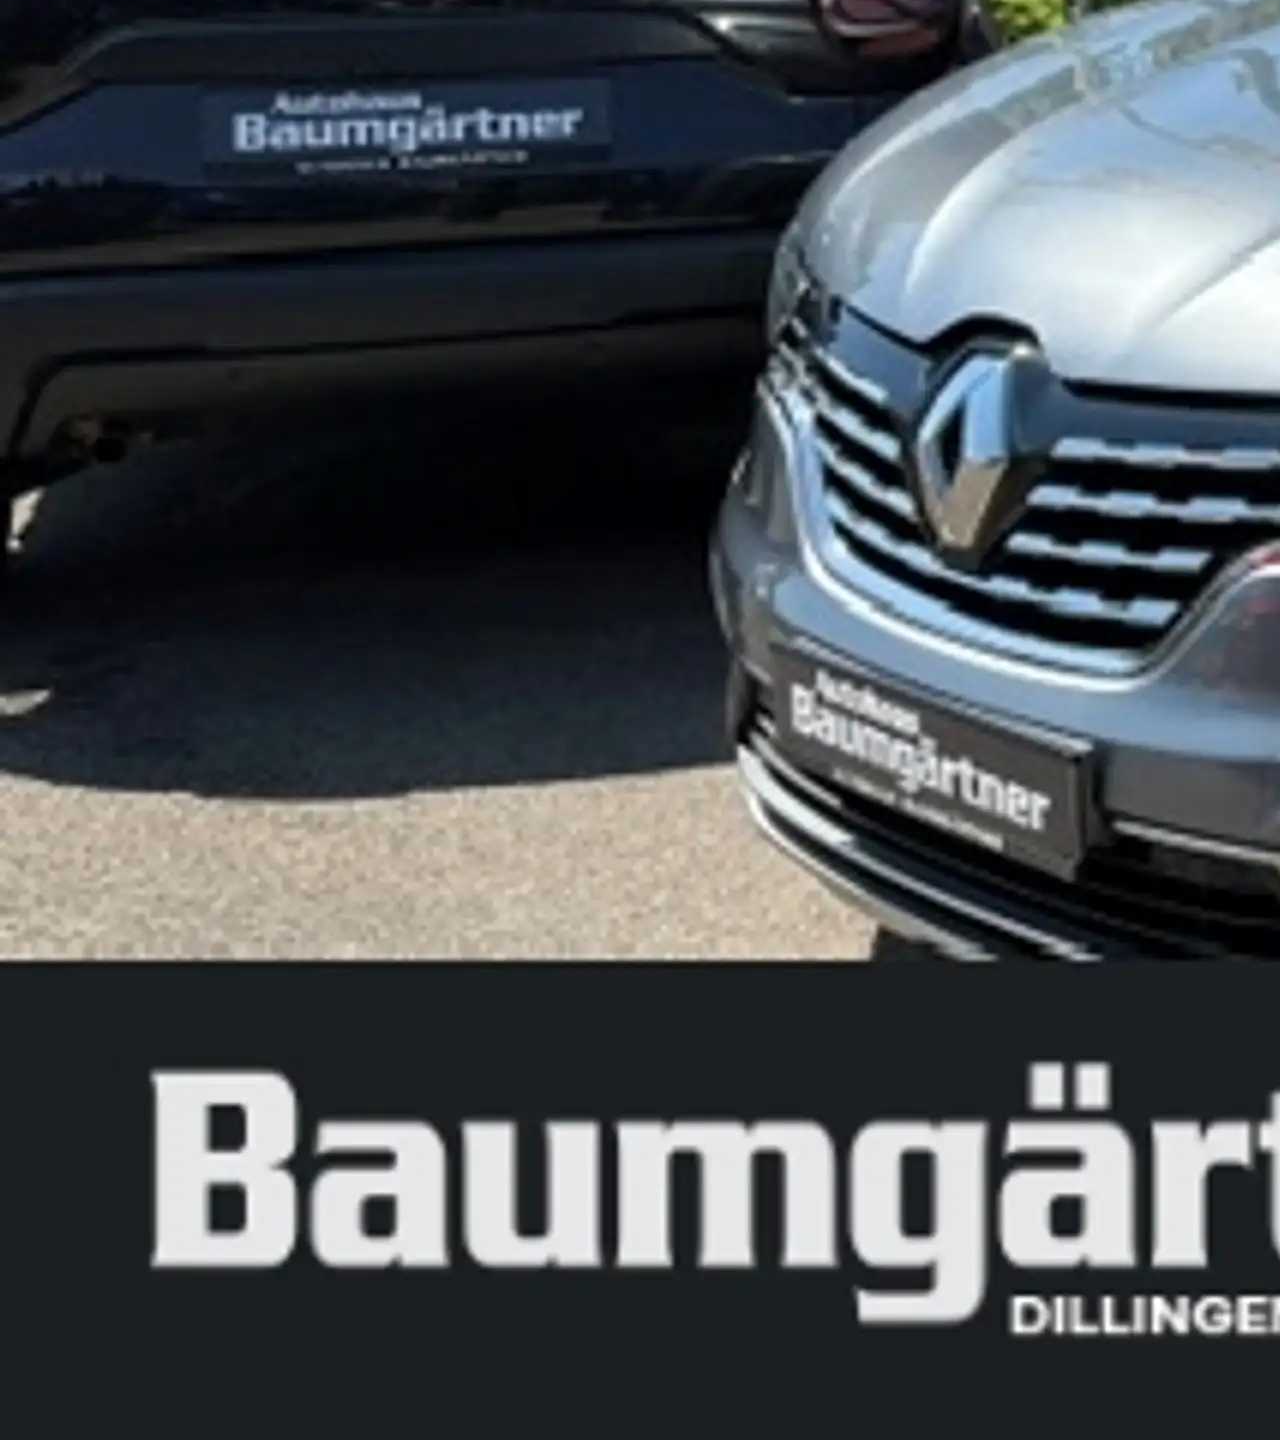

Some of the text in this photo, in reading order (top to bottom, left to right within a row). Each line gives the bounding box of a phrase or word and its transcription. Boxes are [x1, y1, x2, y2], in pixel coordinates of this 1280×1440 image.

[232, 102, 584, 157] Baumgärtner
[813, 667, 921, 735] Autohaus
[790, 682, 1052, 831] Baumgärtner
